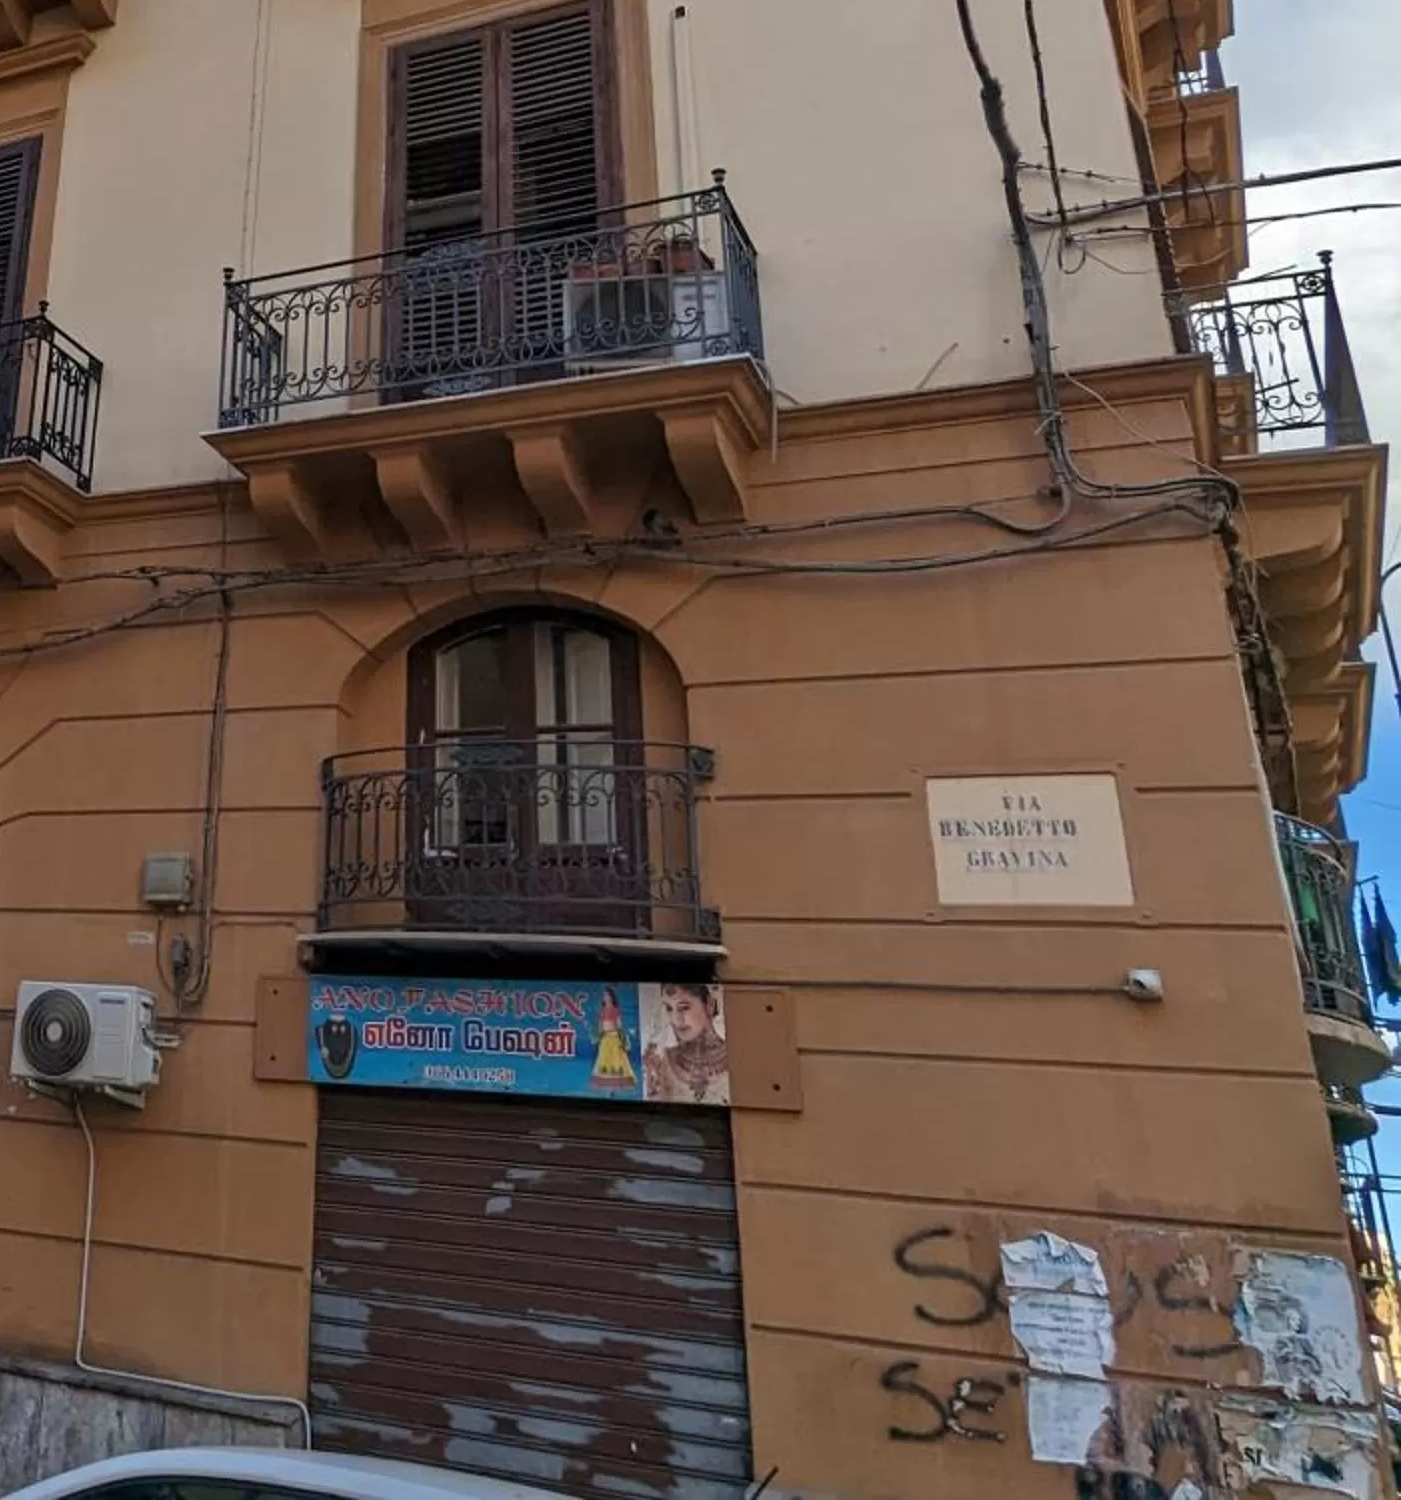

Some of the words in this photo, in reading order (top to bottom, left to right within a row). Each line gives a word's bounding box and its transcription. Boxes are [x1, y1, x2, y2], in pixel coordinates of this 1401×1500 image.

[1001, 795, 1042, 812] VIA
[938, 819, 1078, 838] BENEDETTO
[966, 851, 1069, 869] GRAVINA
[397, 986, 588, 1019] FASHION
